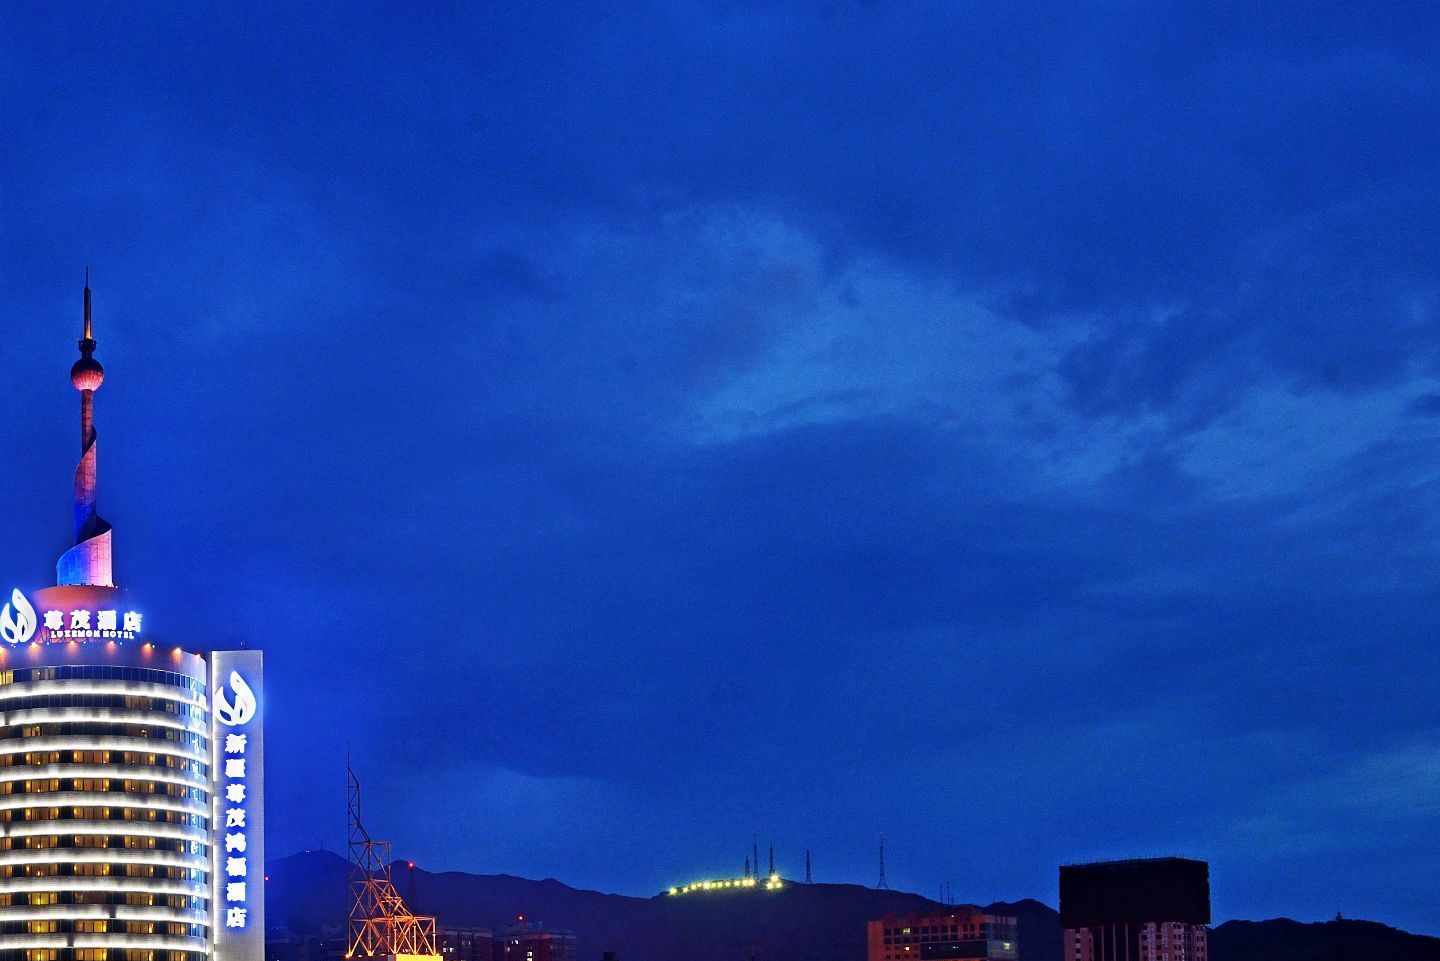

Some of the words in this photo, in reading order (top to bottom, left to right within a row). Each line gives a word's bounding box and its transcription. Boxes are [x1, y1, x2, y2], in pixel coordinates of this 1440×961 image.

[43, 610, 142, 632] 尊茂酒店
[103, 631, 134, 639] HOTEL
